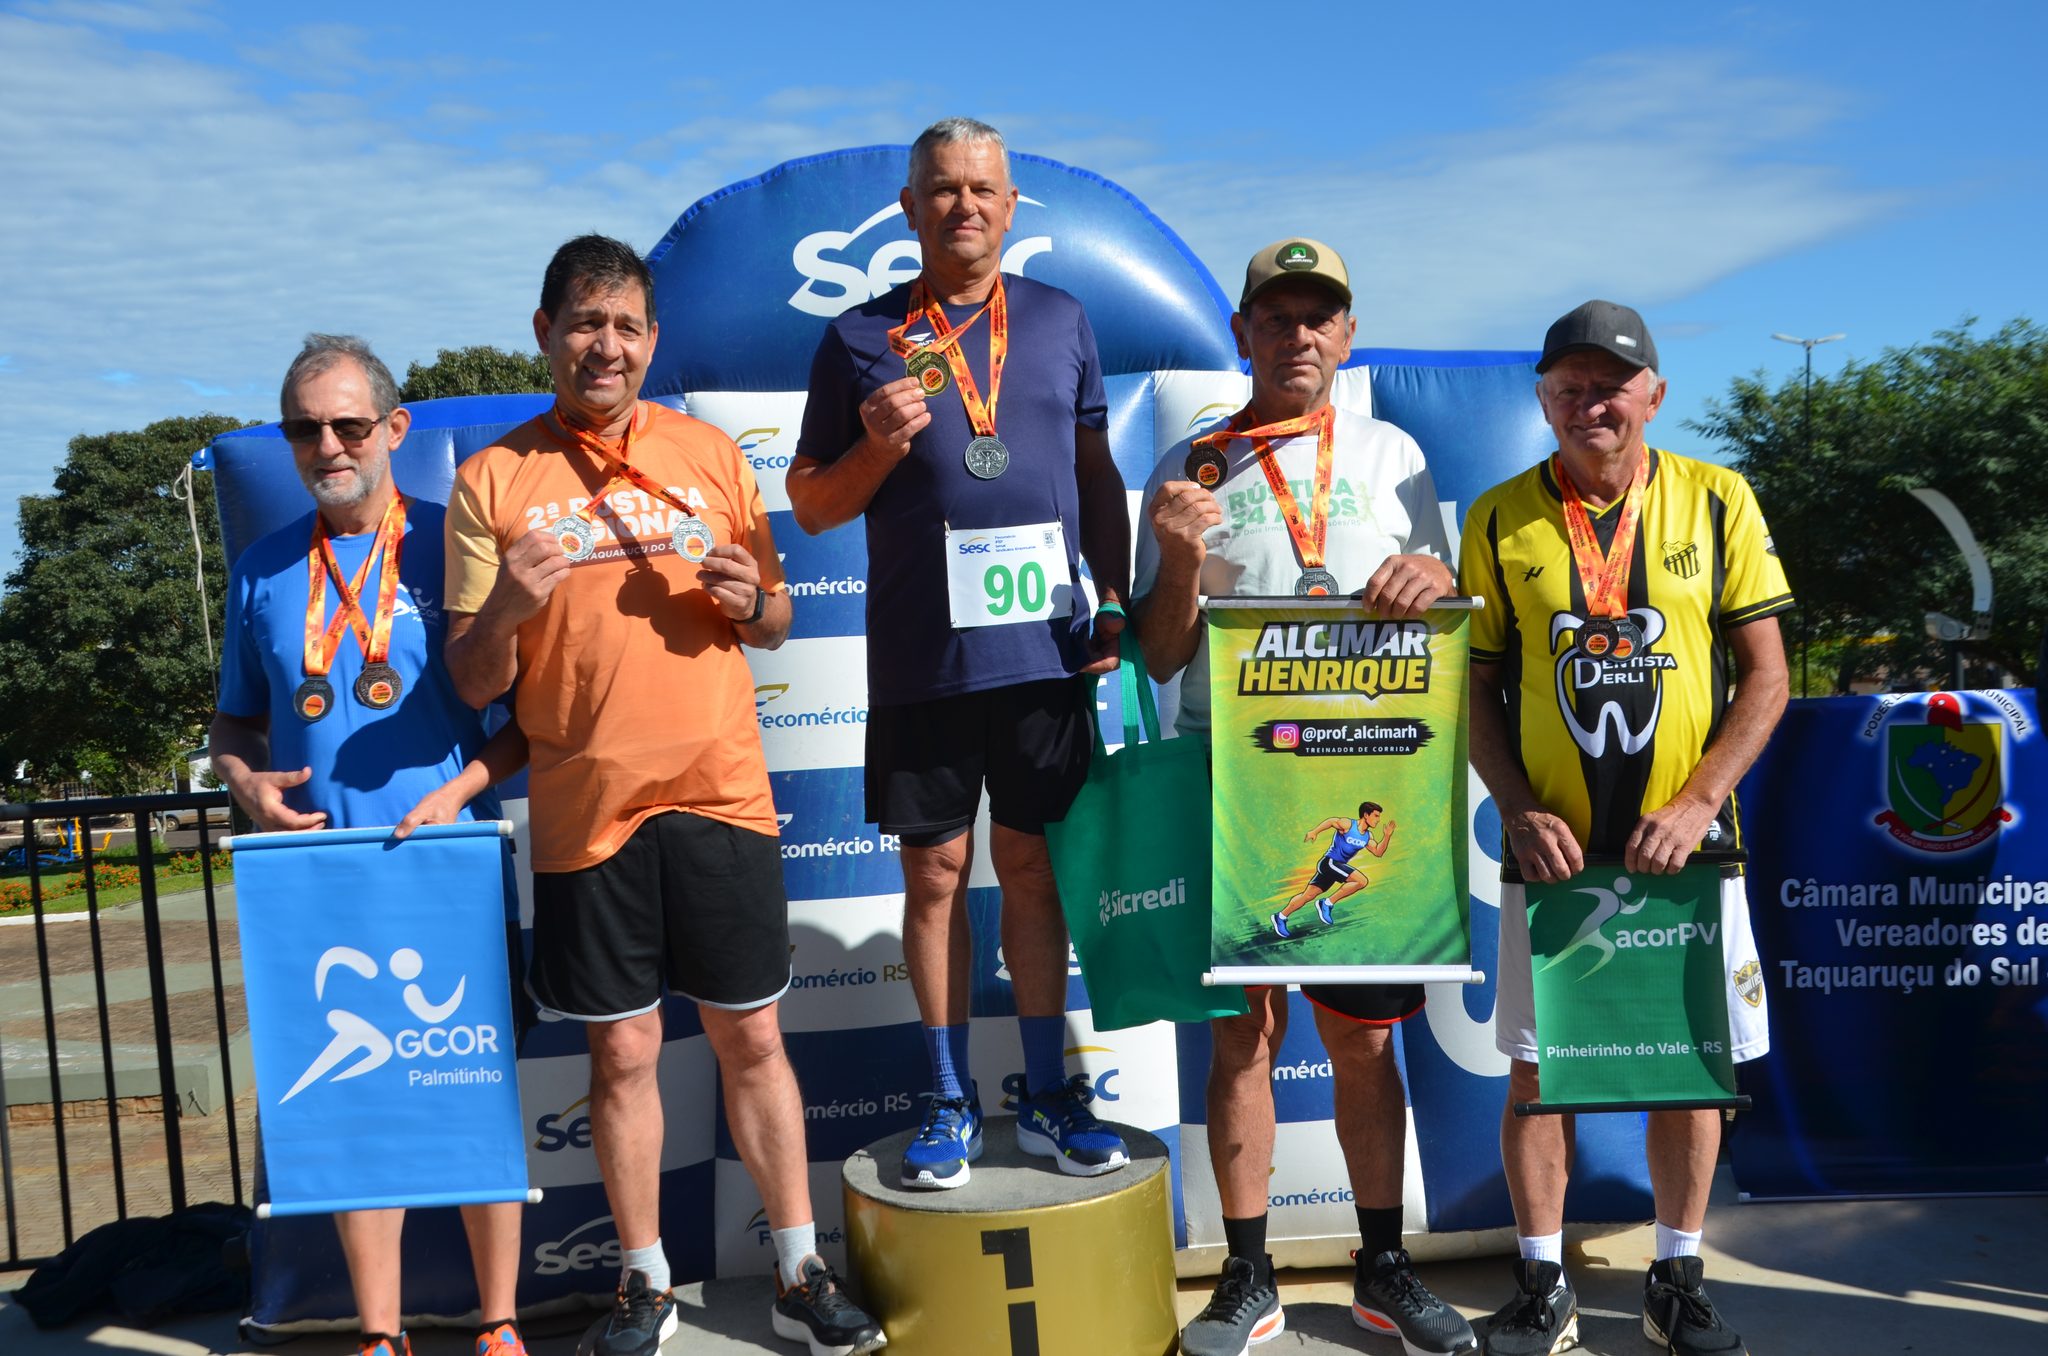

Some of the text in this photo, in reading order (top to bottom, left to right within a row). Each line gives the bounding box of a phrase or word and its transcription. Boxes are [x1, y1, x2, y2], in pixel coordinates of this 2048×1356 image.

[787, 230, 1053, 318] Sec
[1228, 478, 1354, 512] RÚTIA
[1231, 506, 1266, 530] 34
[1328, 518, 1361, 527] sões/RS
[650, 543, 666, 553] DO
[785, 576, 866, 597] omércio
[984, 561, 1046, 616] 90
[1256, 623, 1427, 658] ALCIMAR
[1243, 658, 1427, 696] HENRIQUE
[1864, 698, 1894, 738] PODER
[1302, 725, 1417, 742] @prof_alcimarh
[781, 834, 901, 859] comércio RS
[1346, 837, 1367, 847] GCOR
[1112, 878, 1186, 917] Sicredi
[1780, 875, 2048, 911] Câmara Municipa
[1616, 922, 1718, 949] acorPV
[1836, 916, 2048, 947] Vereadores de
[790, 963, 911, 989] omércio RS
[1779, 959, 1934, 995] Taquaruçu
[1945, 958, 1981, 986] do
[1990, 957, 2039, 986] Sul
[395, 1024, 499, 1059] GCOR
[1546, 1043, 1632, 1058] Pinheirinho
[1635, 1042, 1654, 1055] do
[1657, 1041, 1689, 1055] Vale
[1703, 1041, 1723, 1053] RS
[408, 1067, 503, 1087] Palmitinho
[1272, 1059, 1333, 1081] mérci
[805, 1092, 912, 1121] mércio RS
[1032, 1110, 1060, 1141] FILA
[1267, 1187, 1356, 1208] comércio
